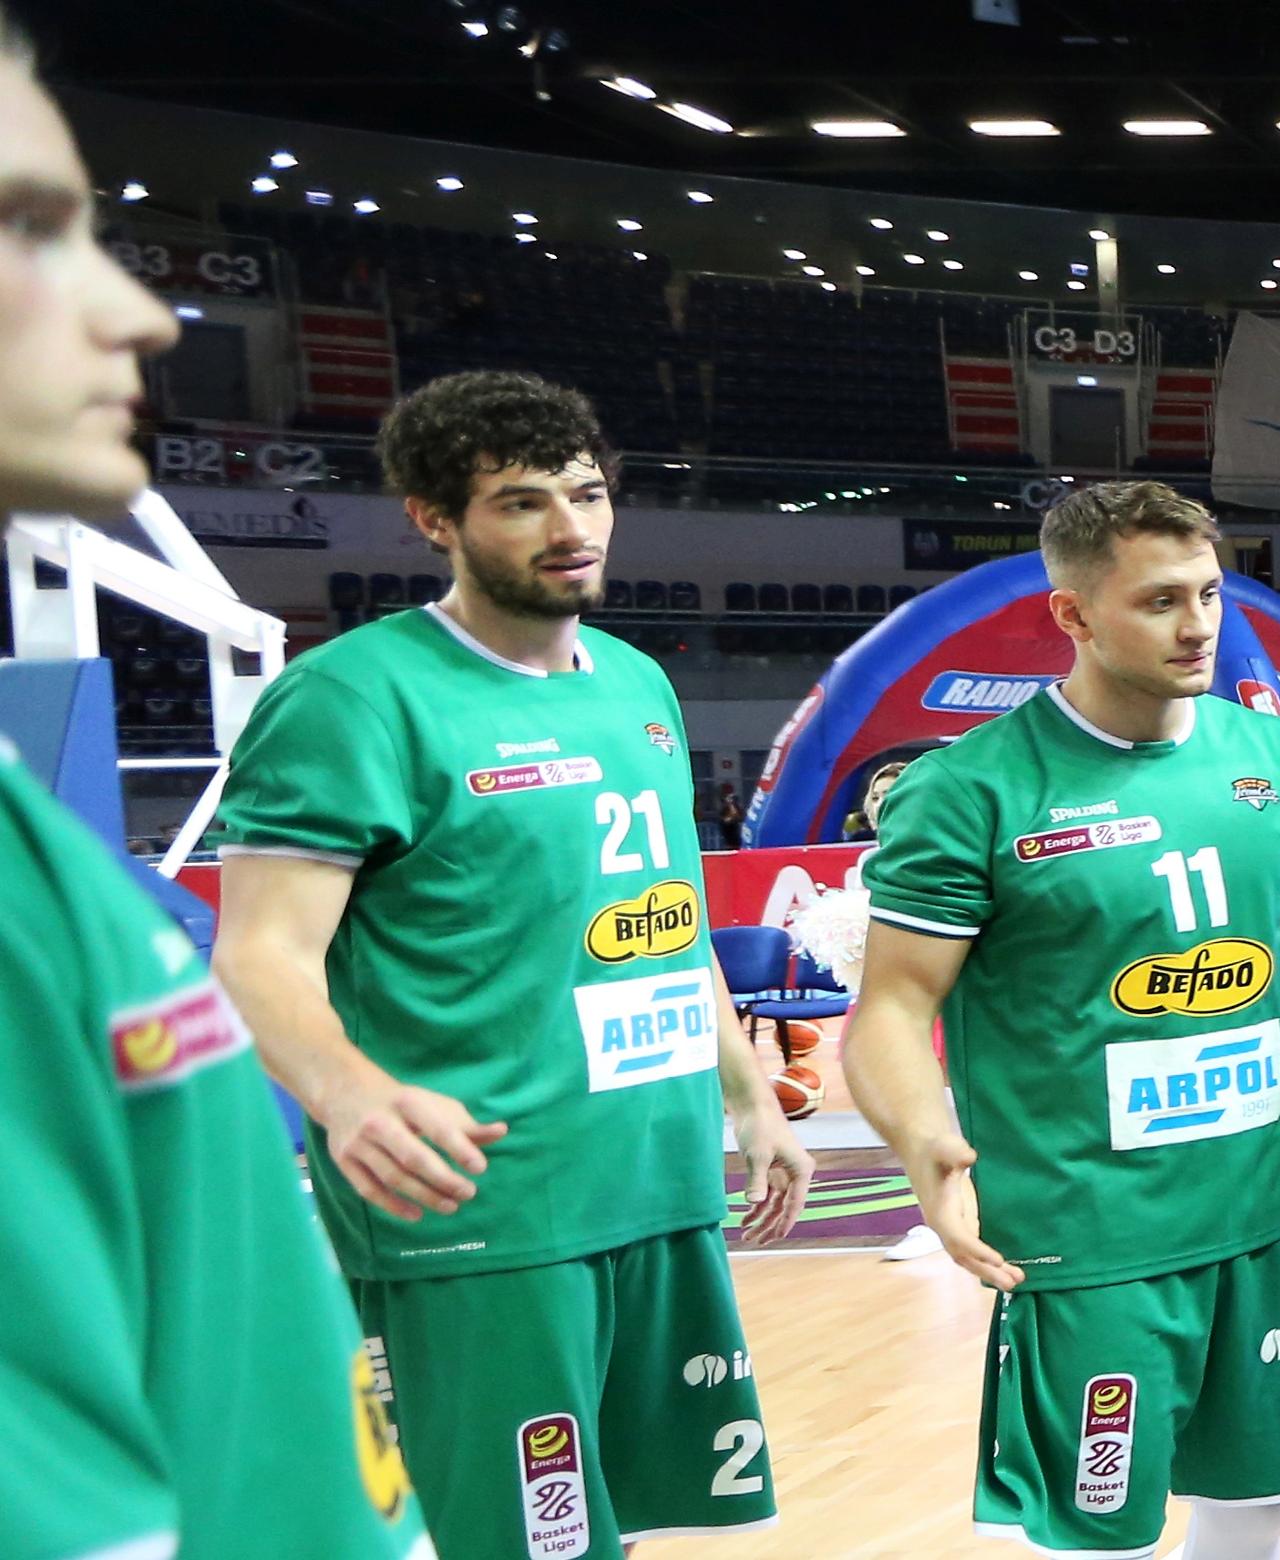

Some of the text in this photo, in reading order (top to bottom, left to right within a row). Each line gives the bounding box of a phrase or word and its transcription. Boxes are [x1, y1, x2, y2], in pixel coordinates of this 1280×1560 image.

[198, 251, 261, 287] C3
[1034, 326, 1136, 356] C3 D3
[157, 437, 324, 481] B2 C2
[940, 677, 1041, 708] RADIO
[498, 770, 539, 786] Energa
[1049, 800, 1120, 824] SPALDING
[594, 789, 670, 876] 21
[1118, 819, 1152, 832] Basket
[1121, 830, 1144, 842] Liga
[1043, 834, 1087, 851] Energa
[1151, 846, 1229, 933] 11
[601, 1001, 713, 1054] ARPOL
[1127, 1055, 1279, 1114] ARPOL
[1090, 1414, 1127, 1427] Energa
[530, 1453, 572, 1471] Energa
[711, 1418, 765, 1497] 2
[1078, 1481, 1126, 1493] Basket
[1086, 1494, 1115, 1505] Liga
[531, 1521, 585, 1543] Basket
[543, 1537, 577, 1554] Liga
